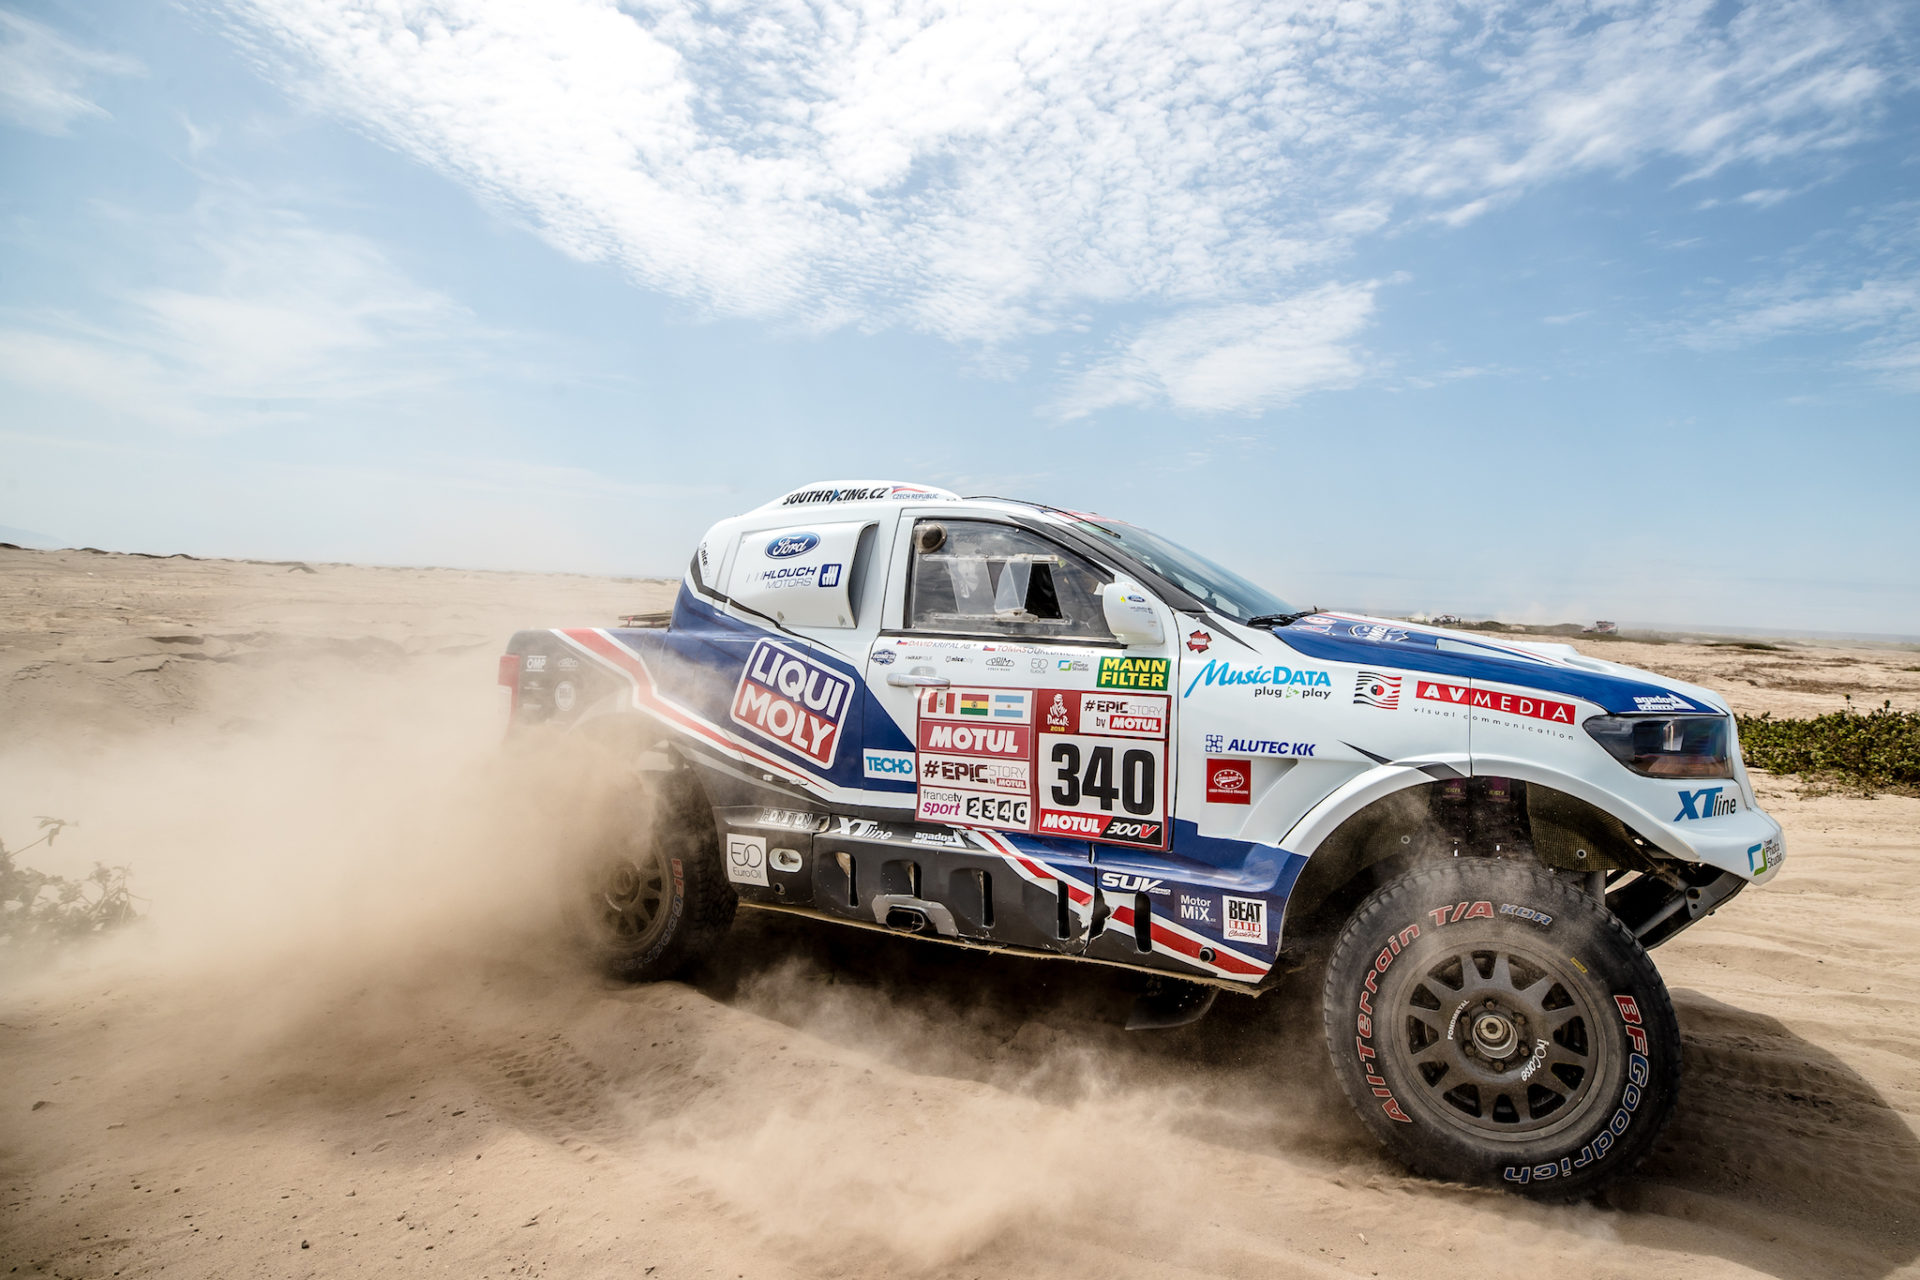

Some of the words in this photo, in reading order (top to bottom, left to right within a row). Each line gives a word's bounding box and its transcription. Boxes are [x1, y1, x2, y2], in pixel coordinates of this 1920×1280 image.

[772, 536, 810, 556] Ford
[762, 566, 817, 580] HLOUCH
[765, 577, 812, 589] MOTORS
[1102, 657, 1166, 673] MANN
[751, 645, 845, 718] LIQUI
[1100, 671, 1165, 687] FILTER
[1254, 686, 1282, 698] plug
[1302, 687, 1331, 699] play
[739, 684, 835, 756] MOLY
[1096, 716, 1106, 728] by
[1111, 717, 1159, 731] MOTUL
[1413, 707, 1455, 718] visual
[1463, 714, 1574, 741] communication
[928, 725, 1018, 754] MOTUL
[1228, 739, 1290, 754] ALUTEC
[1291, 742, 1316, 756] KK
[997, 778, 1026, 788] MOTUL
[1051, 743, 1155, 816] 340
[923, 789, 962, 802] francetv
[922, 802, 960, 816] sport
[1041, 812, 1101, 833] MOTUL
[1106, 821, 1159, 839] 300V
[1101, 872, 1163, 892] SUV
[1180, 894, 1211, 907] Motor
[1228, 899, 1262, 923] BEAT
[1356, 923, 1420, 1123] All-Terrain
[1428, 901, 1495, 926] T/A
[1503, 993, 1650, 1184] BFGoodrich
